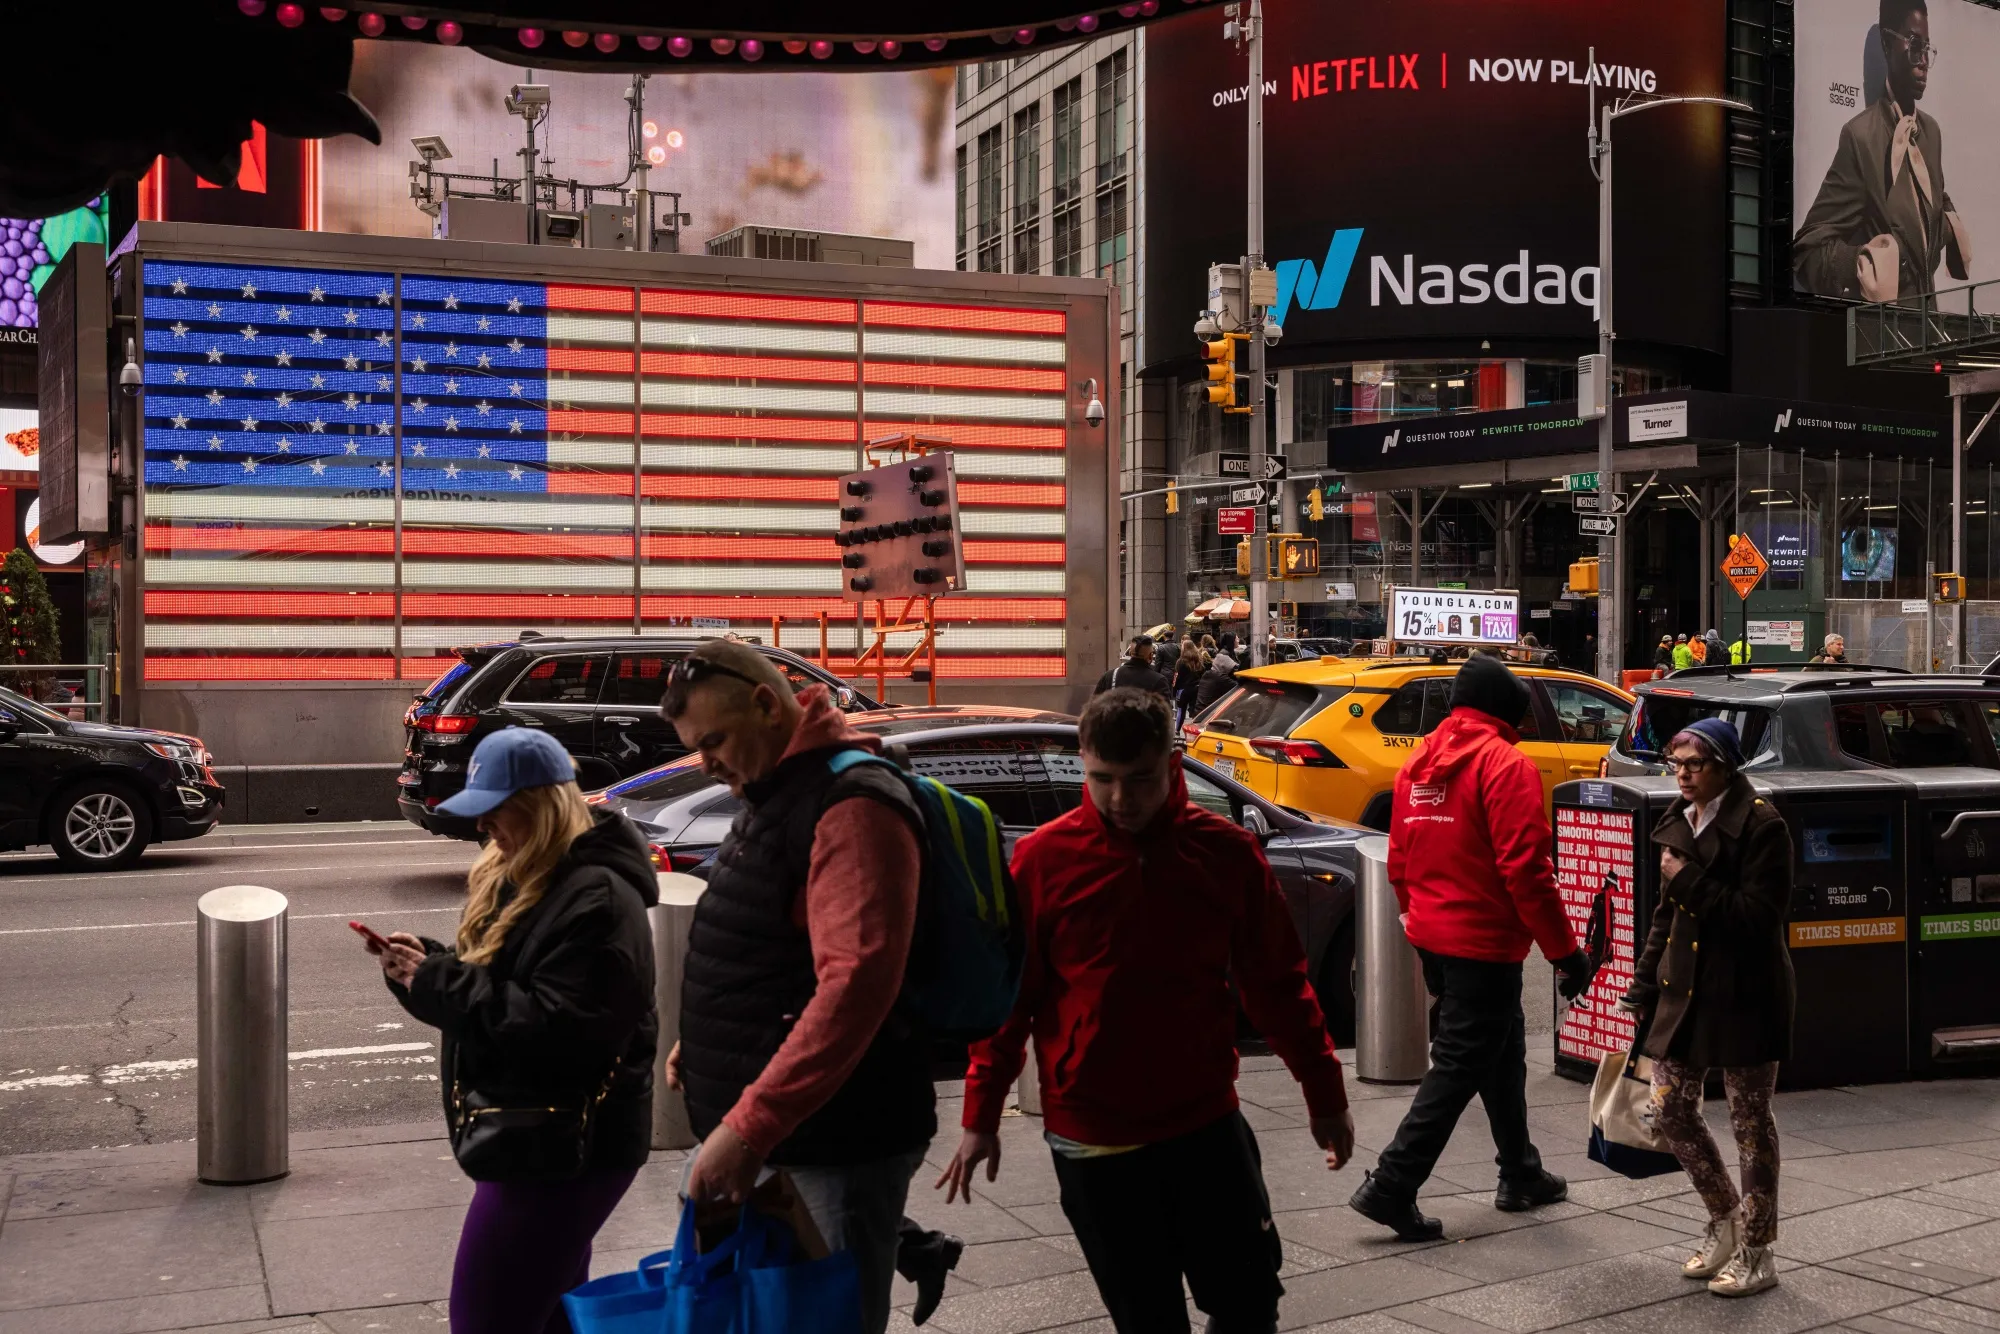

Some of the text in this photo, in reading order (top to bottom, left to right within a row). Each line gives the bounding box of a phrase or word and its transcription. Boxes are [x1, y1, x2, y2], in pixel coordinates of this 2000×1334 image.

[1292, 53, 1420, 102] NETFLIX
[1469, 58, 1657, 93] NOW PLAYING
[1212, 86, 1249, 107] ONLY
[1829, 82, 1860, 97] JACKET
[1829, 93, 1856, 108] $35.99
[1370, 249, 1600, 322] Nasdaq
[1406, 419, 1584, 443] QUESTION TODAY REWRITE TOMORROW
[1643, 419, 1673, 430] Turner
[1797, 417, 1937, 438] QUESTION TODAY REWRITE TOMORROW
[1228, 461, 1248, 471] ONE
[1571, 476, 1579, 488] W
[1581, 475, 1591, 487] 43
[1235, 489, 1262, 501] ONE WAY
[1580, 498, 1597, 506] ONE
[1584, 520, 1612, 530] ONE WAY
[1389, 541, 1435, 552] Nasaq
[1730, 566, 1758, 576] WORK ZONE
[1401, 595, 1513, 610] YOUNGLA.COM
[1424, 625, 1436, 636] off
[1485, 621, 1512, 639] TAXI
[1374, 640, 1387, 655] 3K97
[1382, 736, 1415, 748] 3K97
[1557, 809, 1633, 829] JAM BAD MONEY
[1557, 825, 1633, 846] SMOOTH CRIMINAL
[1557, 841, 1574, 854] BILLIE
[1575, 843, 1590, 857] JEAN
[1597, 846, 1611, 860] WANT
[1611, 847, 1621, 861] YOU
[1557, 856, 1634, 879] BLAME IT ON THE BOOGIE
[1557, 871, 1577, 886] CAN
[1580, 874, 1598, 889] YOU
[1625, 881, 1633, 894] IT
[1839, 886, 1849, 894] TO
[1574, 890, 1591, 904] DON'T
[1611, 895, 1626, 910] BOUT
[1626, 898, 1634, 912] US
[1828, 894, 1867, 905] TSQ.ORG
[1796, 922, 1897, 940] TIMES SQUARE
[1923, 920, 1970, 935] TIMES
[1596, 1001, 1604, 1015] IN
[1604, 1018, 1615, 1033] LOVE
[1559, 1038, 1577, 1054] WANNA
[1578, 1042, 1584, 1056] BE
[1593, 1032, 1605, 1046] I'LL
[1605, 1035, 1615, 1049] BE
